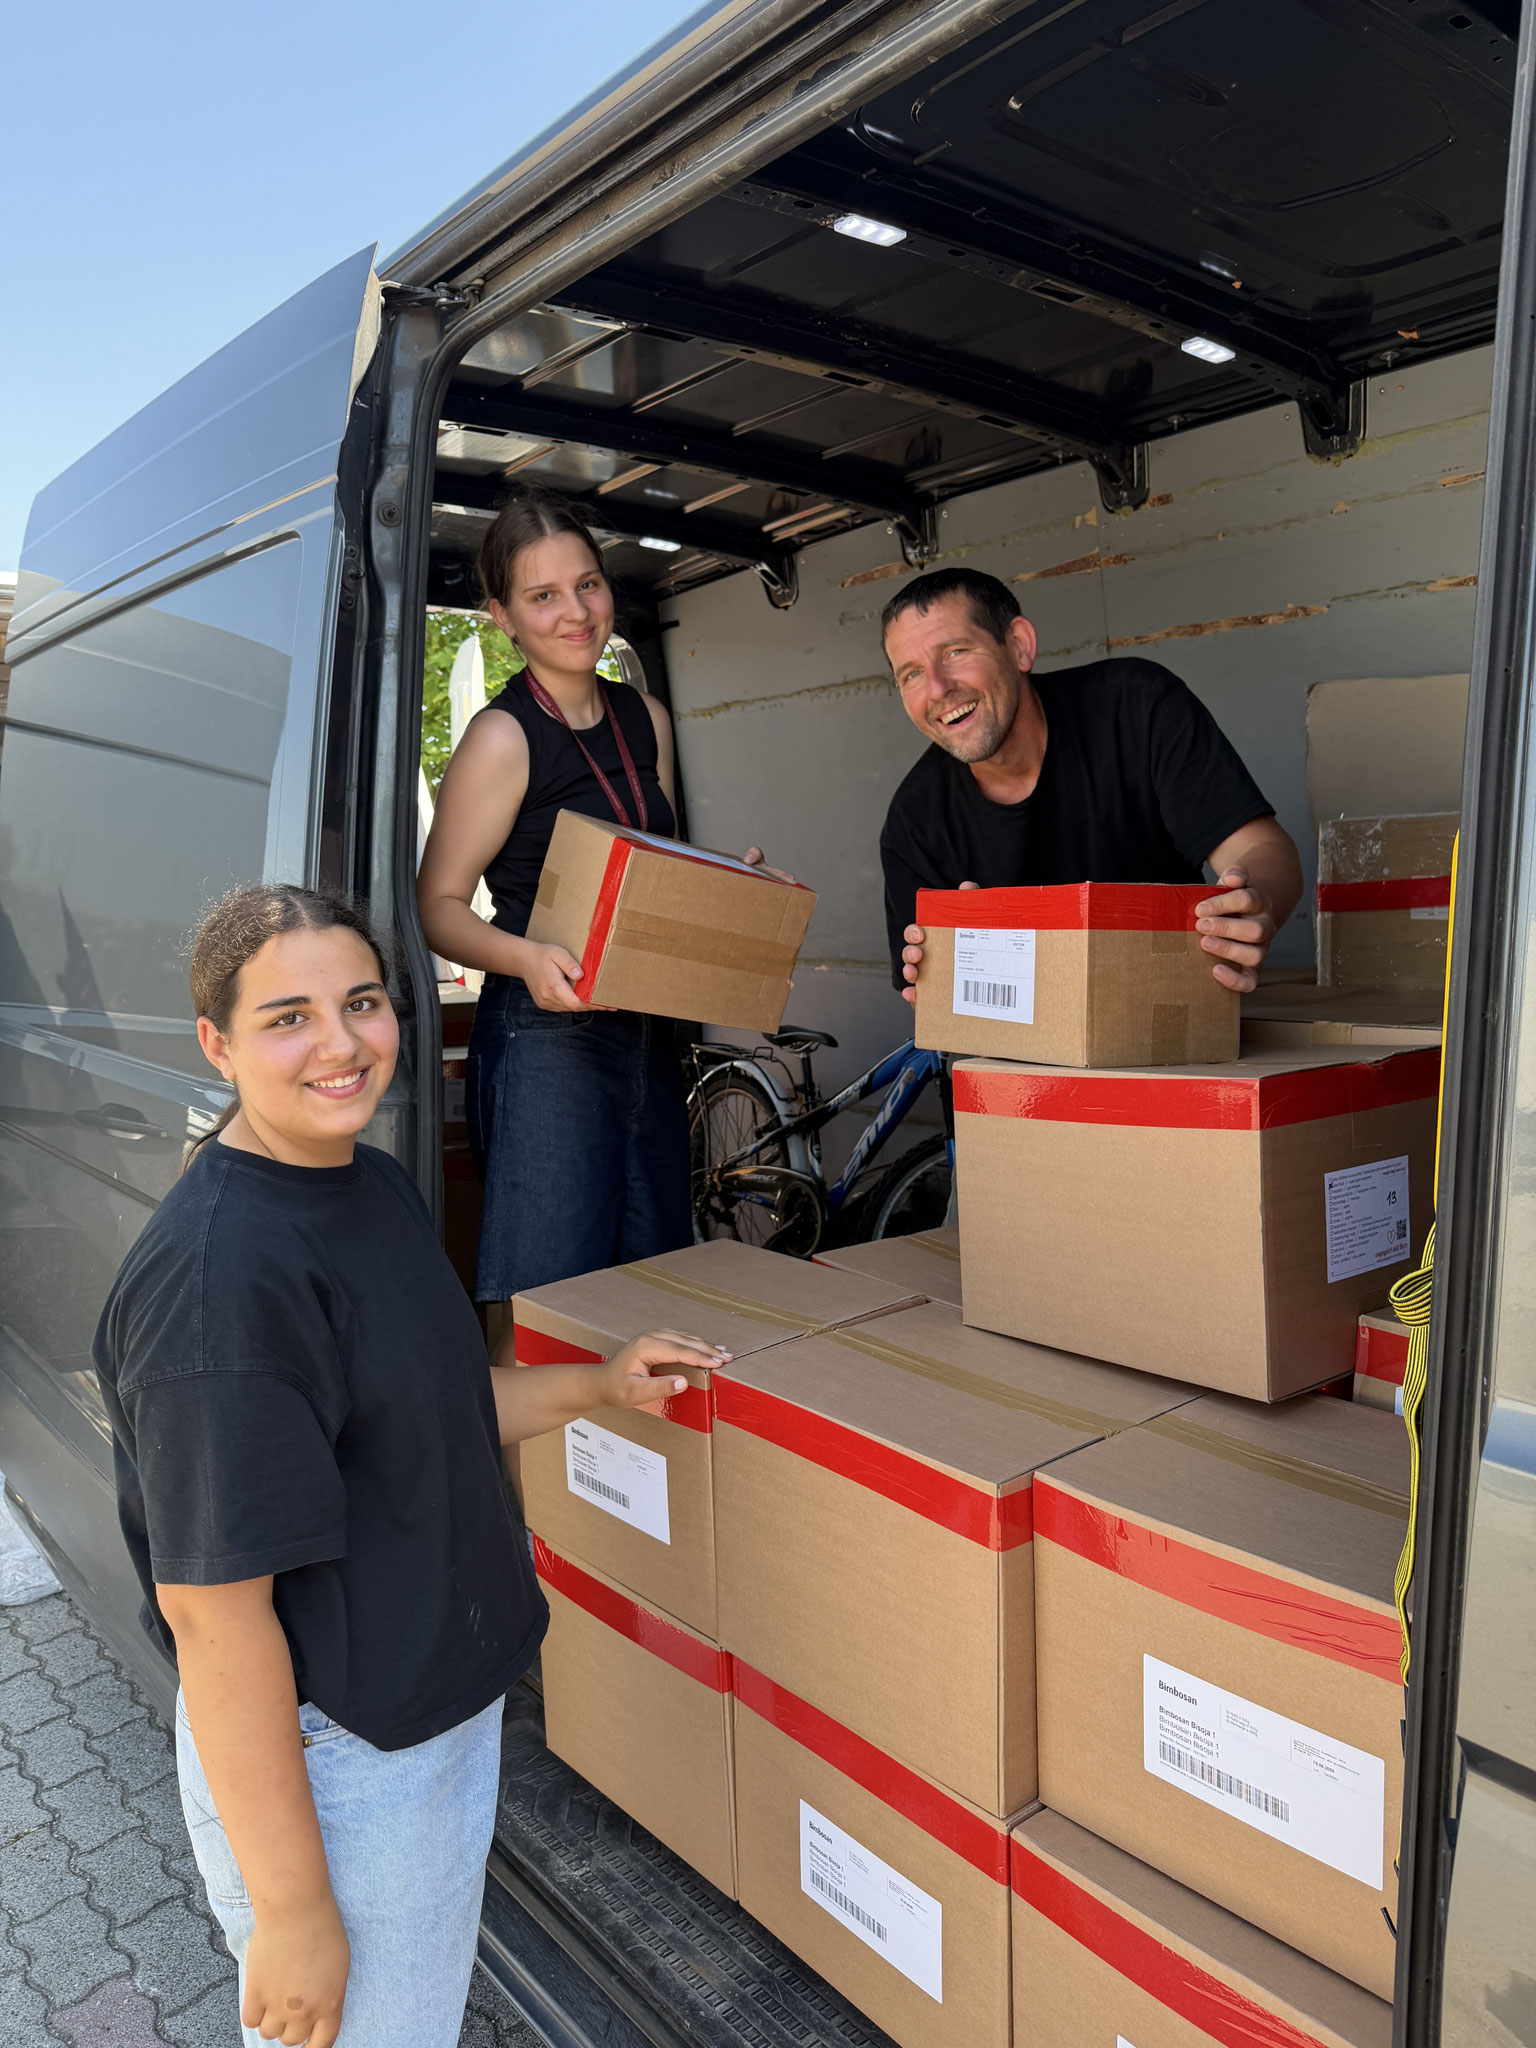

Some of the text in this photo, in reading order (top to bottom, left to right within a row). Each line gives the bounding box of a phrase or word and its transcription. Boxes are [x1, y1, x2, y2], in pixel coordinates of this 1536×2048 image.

[1386, 1189, 1397, 1206] 13
[1158, 1680, 1197, 1706] Bimbosan
[1159, 1705, 1189, 1726] Bimbosan
[1191, 1721, 1211, 1738] Bisoja
[1159, 1714, 1192, 1737] Bimbosan
[1193, 1731, 1214, 1748] Bisoja
[1159, 1723, 1192, 1746] Bimbosan
[1193, 1739, 1214, 1757] Bisoja
